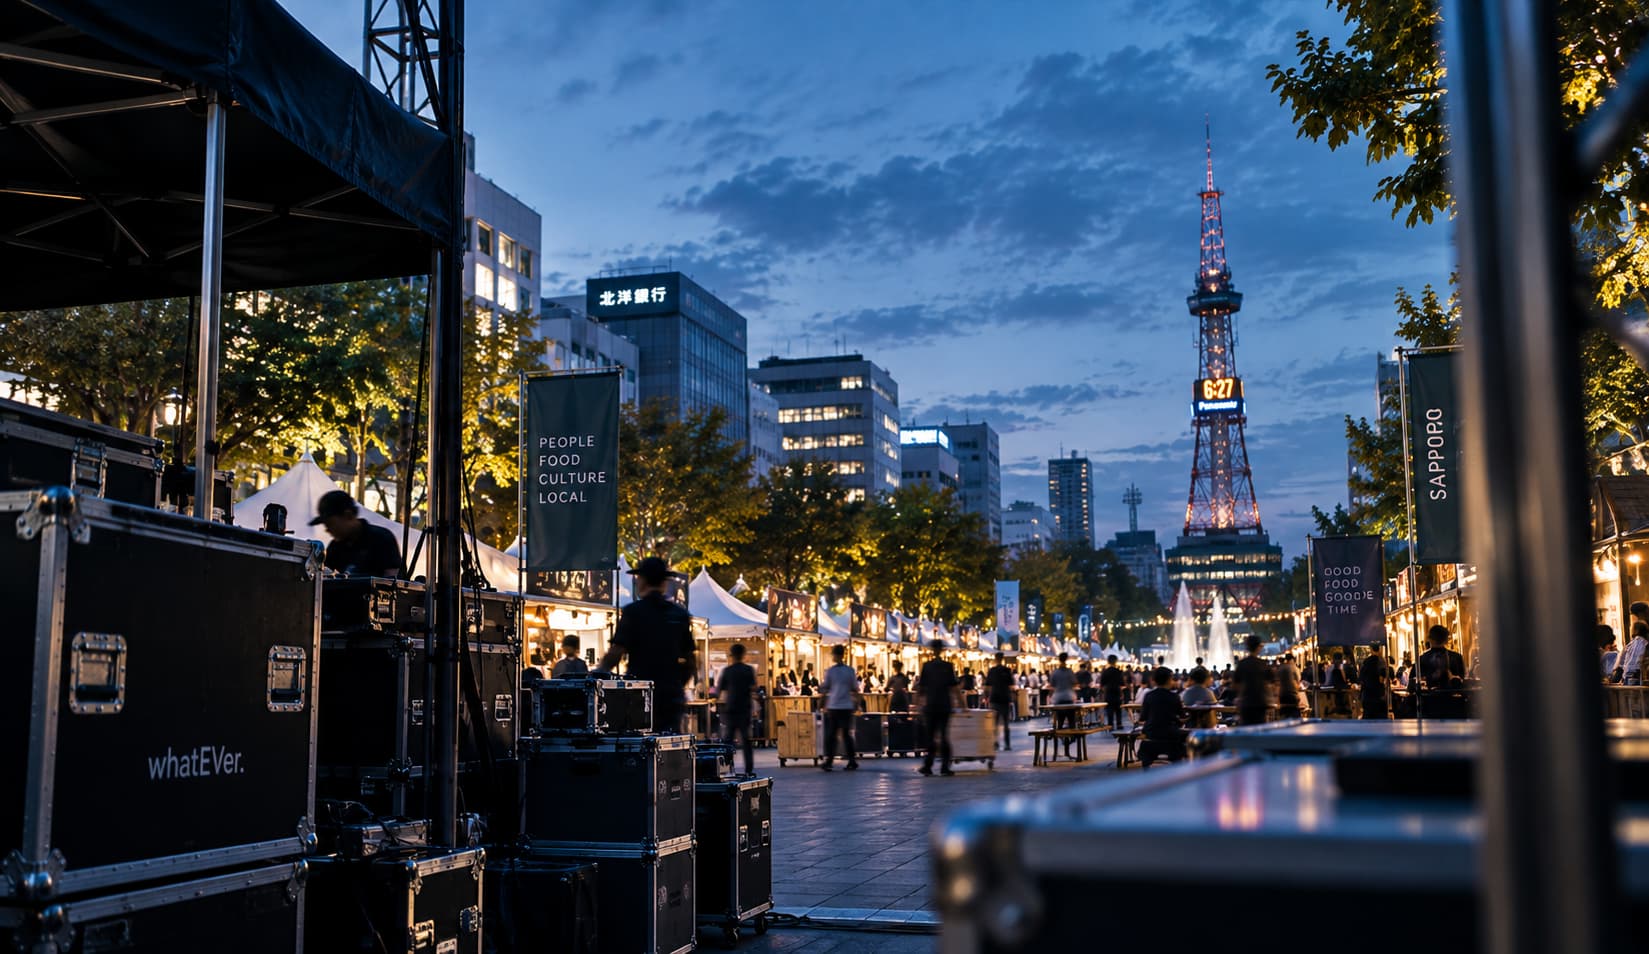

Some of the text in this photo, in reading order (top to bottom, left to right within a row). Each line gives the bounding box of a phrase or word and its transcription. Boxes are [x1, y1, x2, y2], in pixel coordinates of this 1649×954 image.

[1203, 378, 1234, 400] 6:27
[539, 435, 595, 449] PEOPLE
[539, 454, 581, 467] FOOD
[538, 471, 606, 485] CULTURE
[539, 491, 588, 504] LOCAL
[1324, 578, 1359, 589] FOOD
[1327, 605, 1359, 615] TIME
[148, 745, 245, 781] whatEVer.
